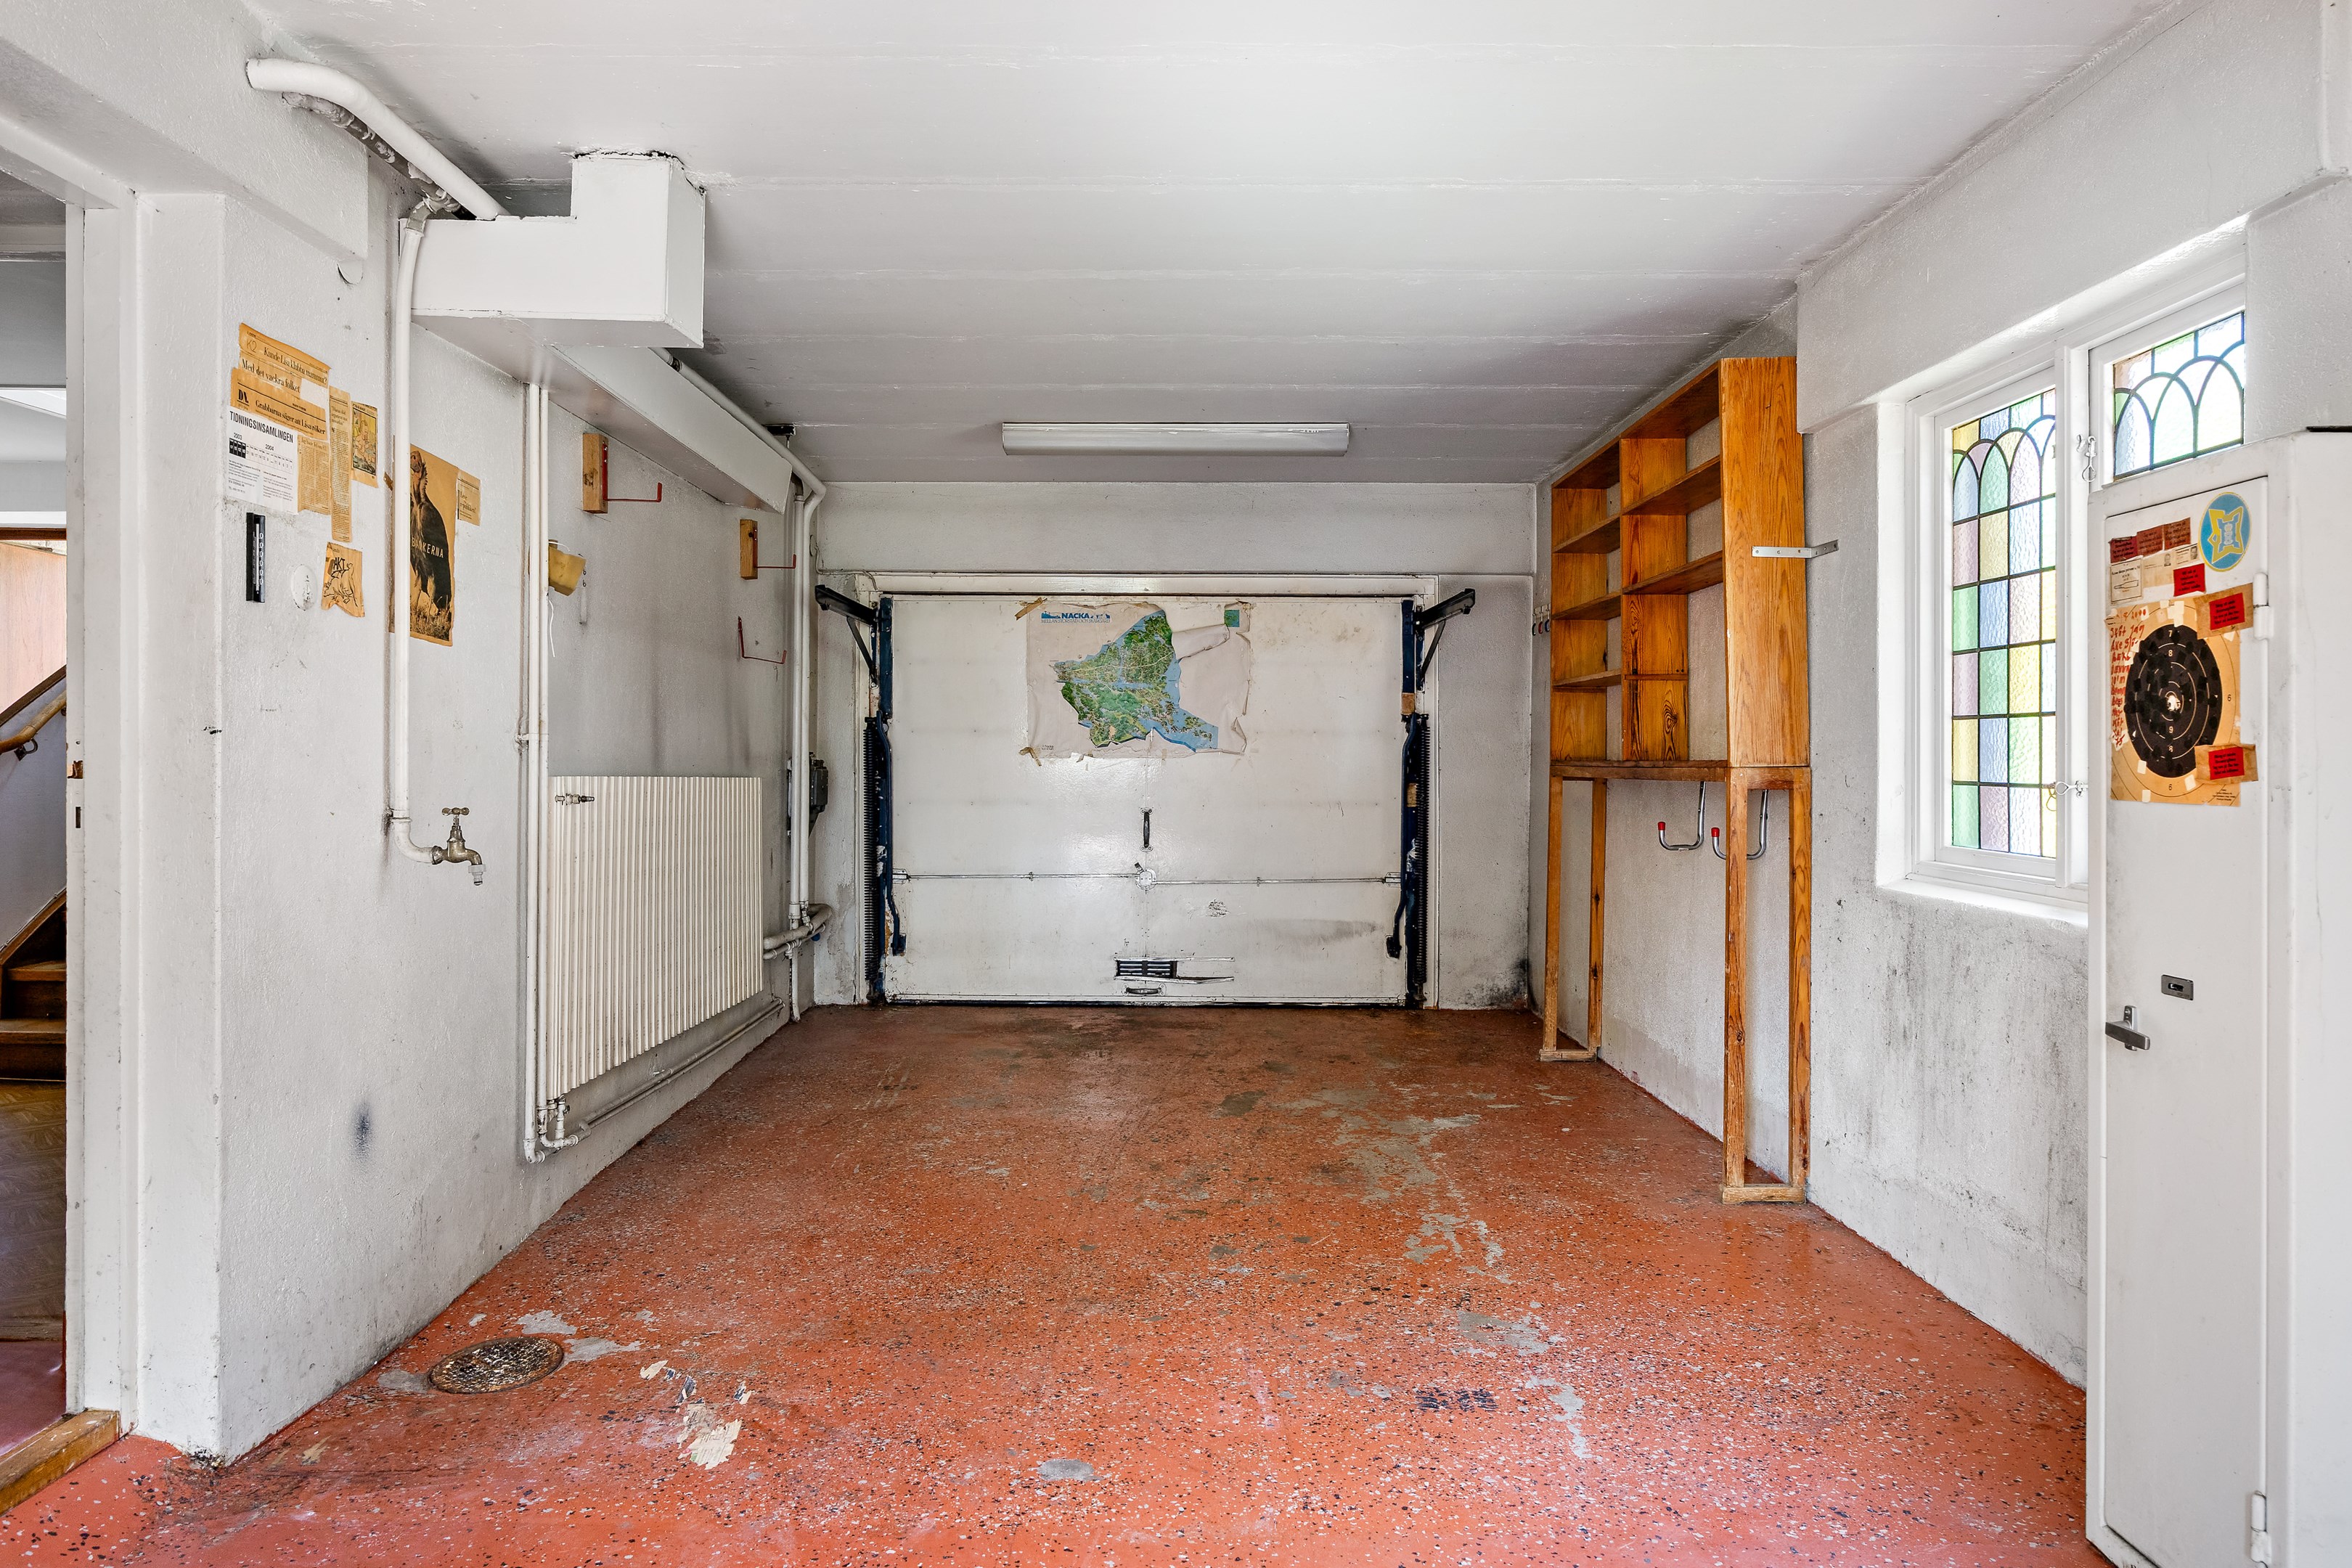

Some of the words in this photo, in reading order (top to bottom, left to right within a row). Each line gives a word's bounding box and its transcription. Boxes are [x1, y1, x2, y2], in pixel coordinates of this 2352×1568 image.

[264, 347, 281, 363] Kunde
[280, 354, 290, 367] Lisa
[242, 359, 255, 373] Med
[256, 366, 265, 378] det
[266, 373, 284, 386] vackra
[285, 379, 301, 393] folket
[229, 410, 293, 444] TIDNINGSINSAMLINGEN
[256, 399, 282, 417] Grabbarna
[282, 409, 294, 424] säger
[301, 419, 311, 430] Lisa
[311, 422, 326, 435] röker
[233, 432, 242, 441] 2003
